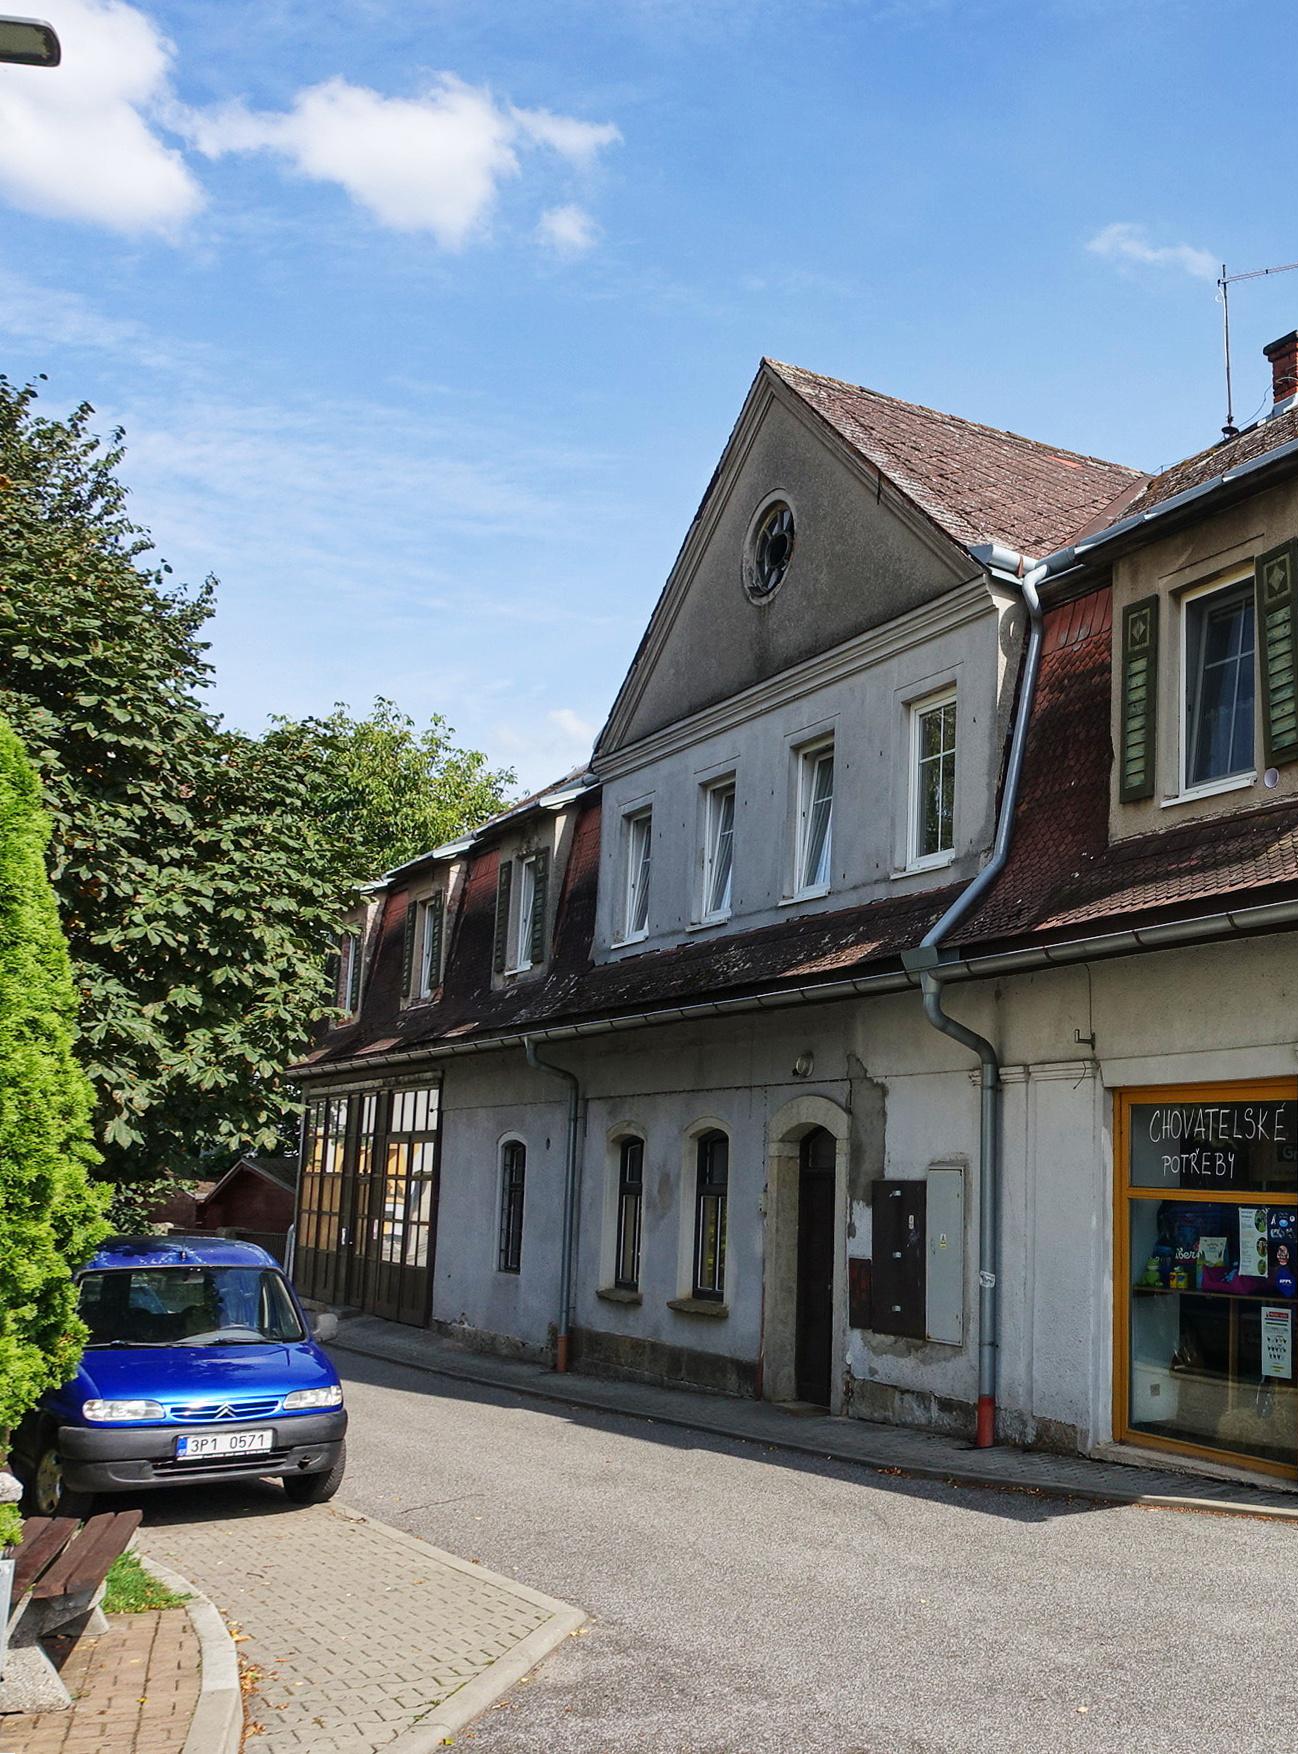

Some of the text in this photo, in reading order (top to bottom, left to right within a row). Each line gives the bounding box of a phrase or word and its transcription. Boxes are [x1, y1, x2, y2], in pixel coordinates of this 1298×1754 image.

[1149, 1102, 1286, 1143] CHOVATELSKÉ
[1161, 1147, 1235, 1179] POTŘEBY
[191, 1434, 265, 1453] 3P1 0571
